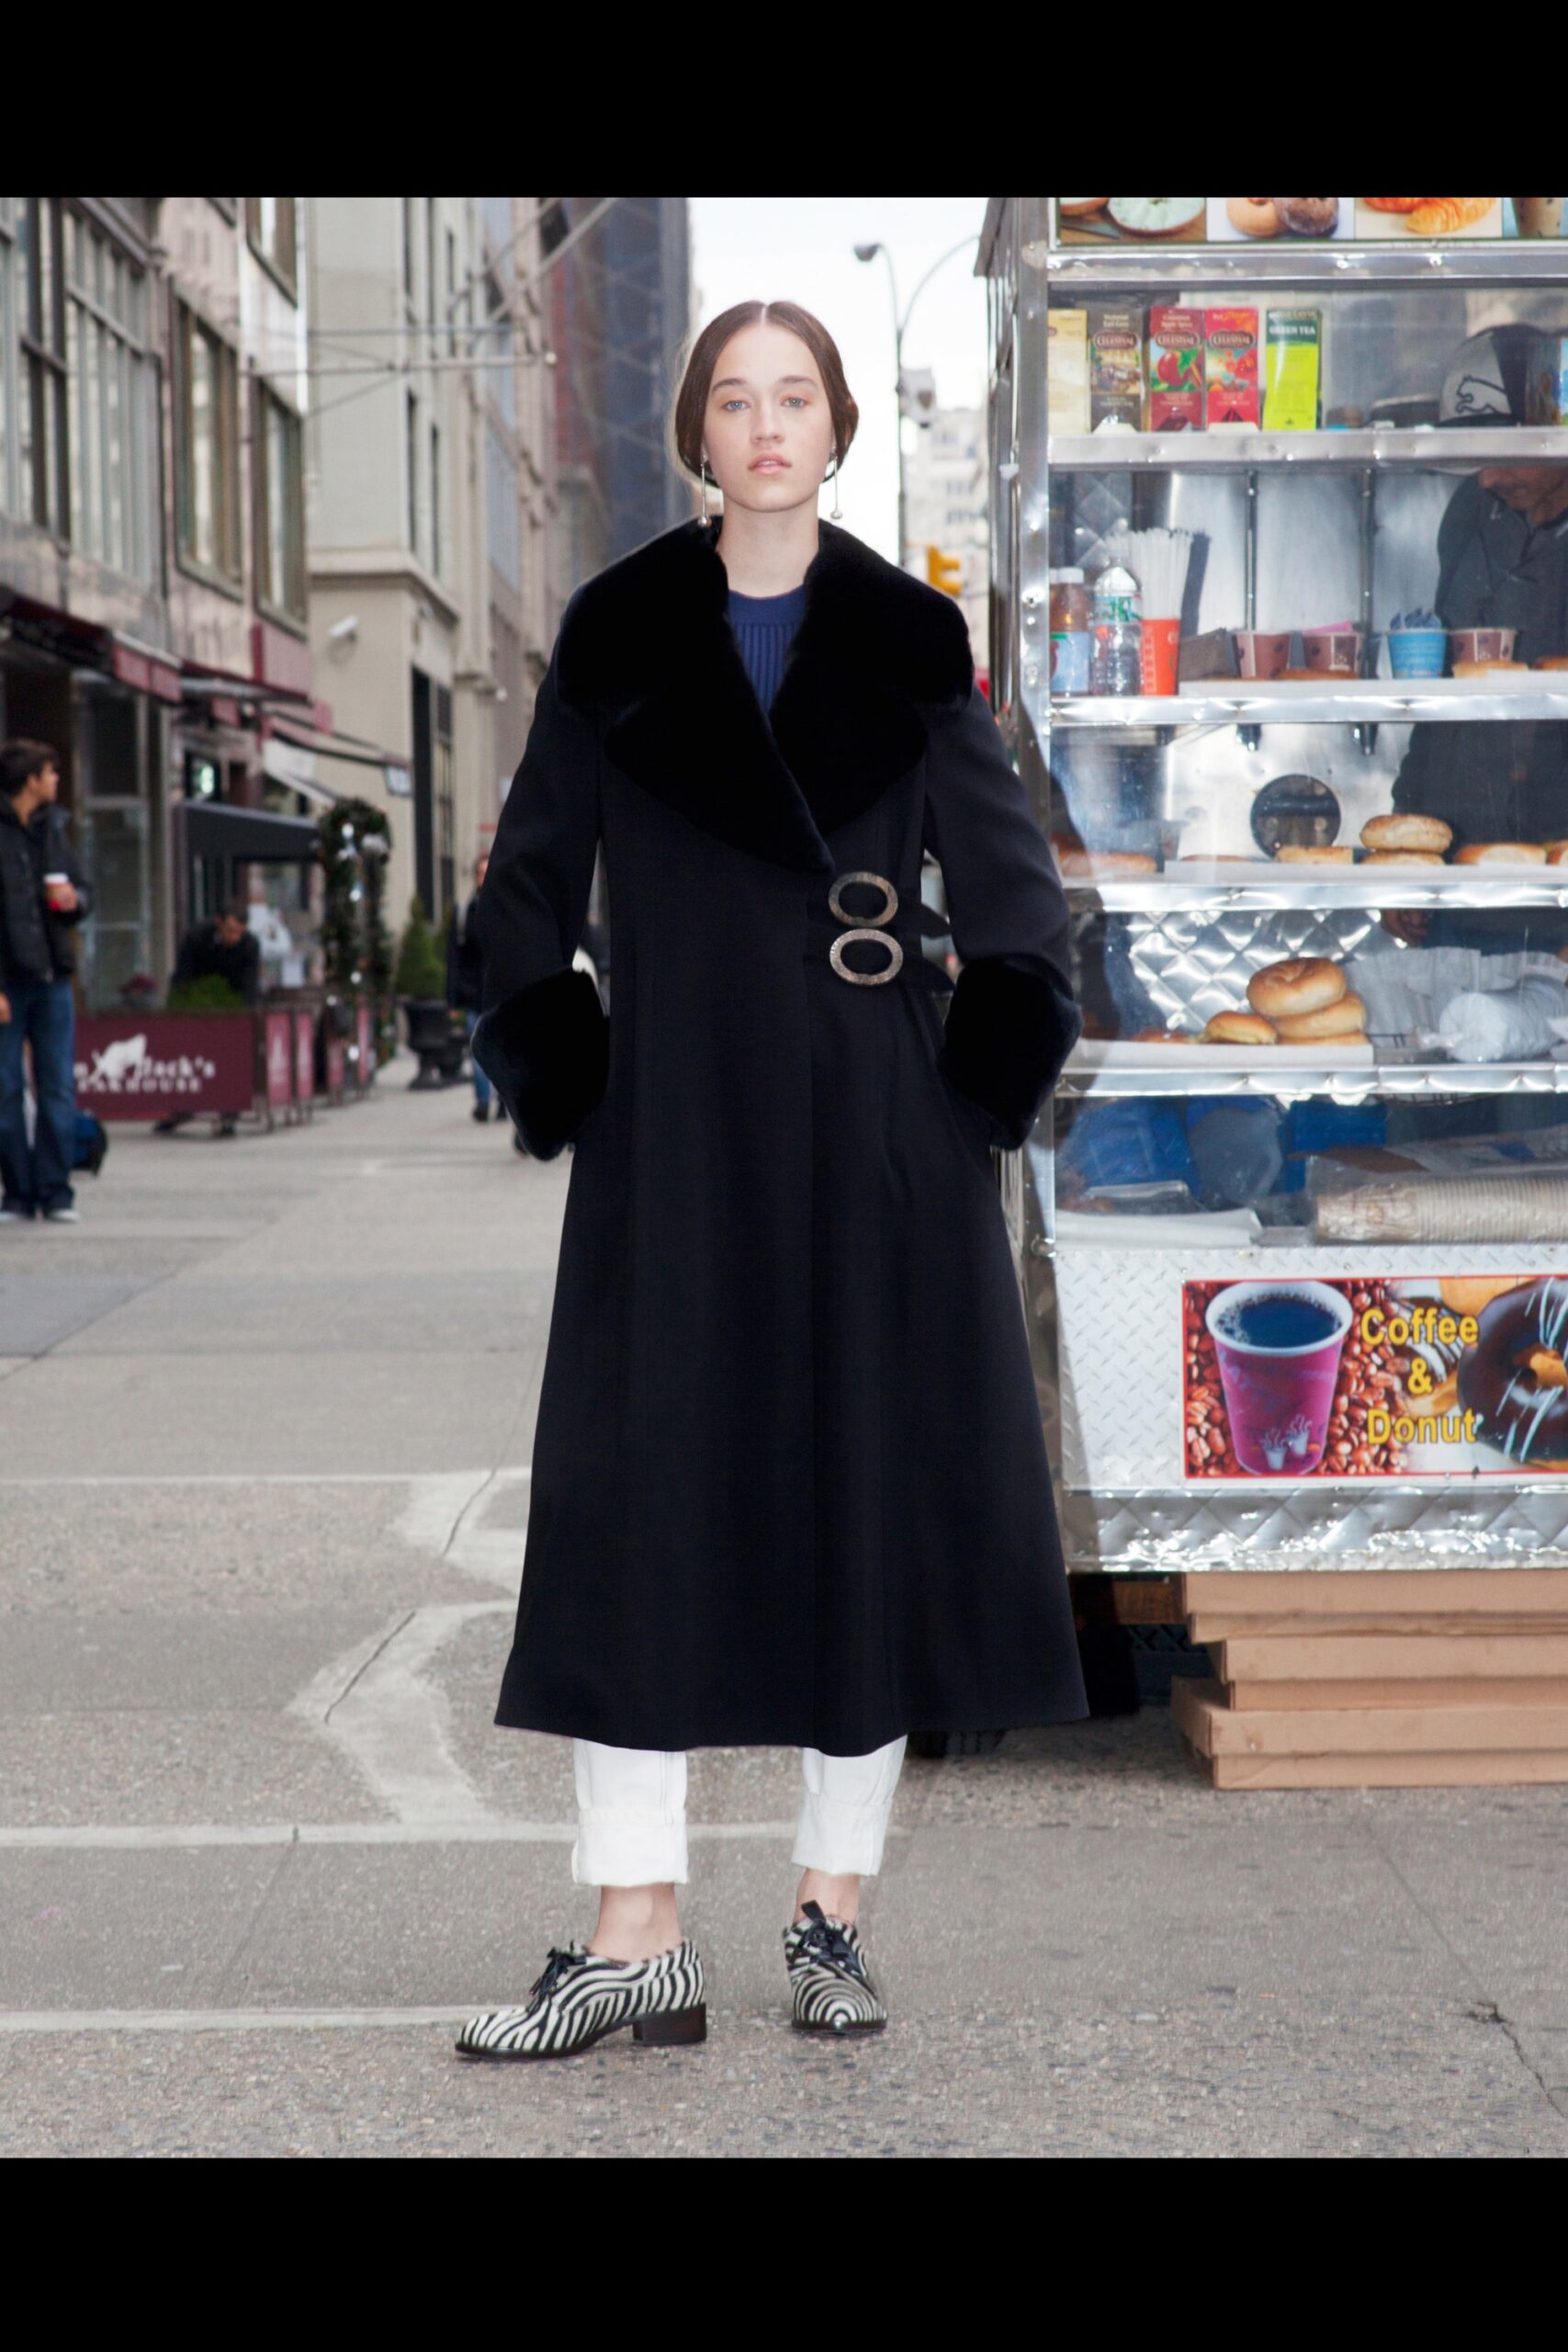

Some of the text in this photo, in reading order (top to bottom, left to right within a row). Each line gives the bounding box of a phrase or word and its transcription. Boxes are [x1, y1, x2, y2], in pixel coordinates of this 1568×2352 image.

[1299, 325, 1316, 335] TEA
[1360, 1307, 1479, 1346] Coffee
[1407, 1357, 1433, 1395] &
[1367, 1408, 1477, 1445] Donut
